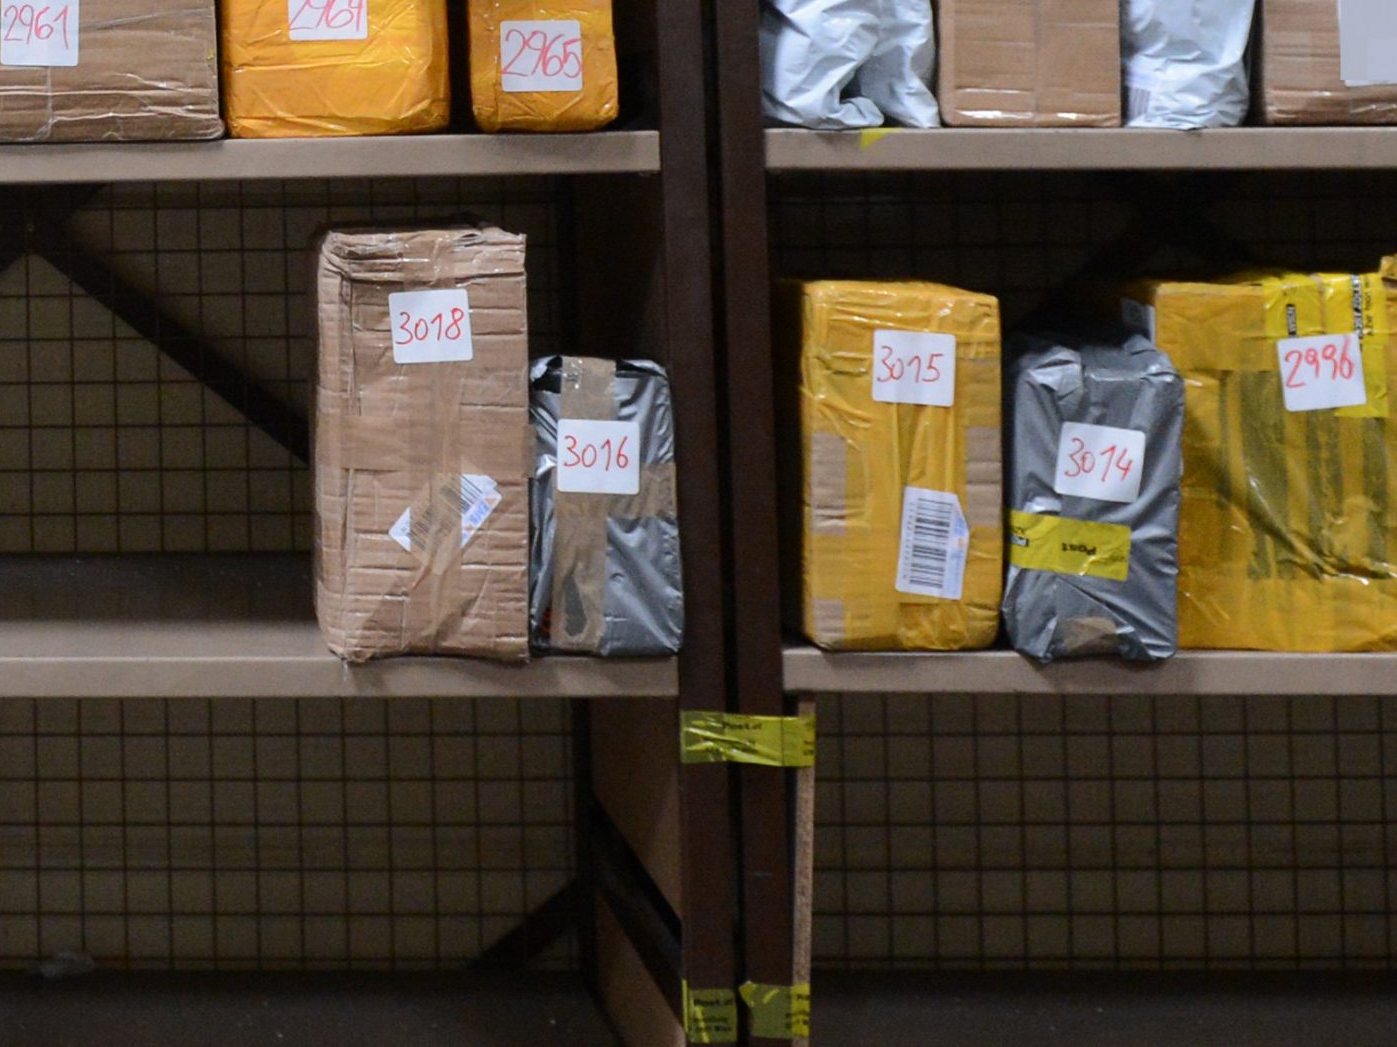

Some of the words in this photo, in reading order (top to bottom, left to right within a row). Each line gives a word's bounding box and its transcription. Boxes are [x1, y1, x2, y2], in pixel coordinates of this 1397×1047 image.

[3, 4, 69, 50] 2961
[503, 29, 583, 80] 2965
[395, 306, 465, 346] 3018
[876, 345, 944, 383] 3015
[1283, 335, 1355, 389] 2996
[562, 435, 630, 471] 3016
[1063, 437, 1133, 482] 3014
[1061, 541, 1098, 556] Post
